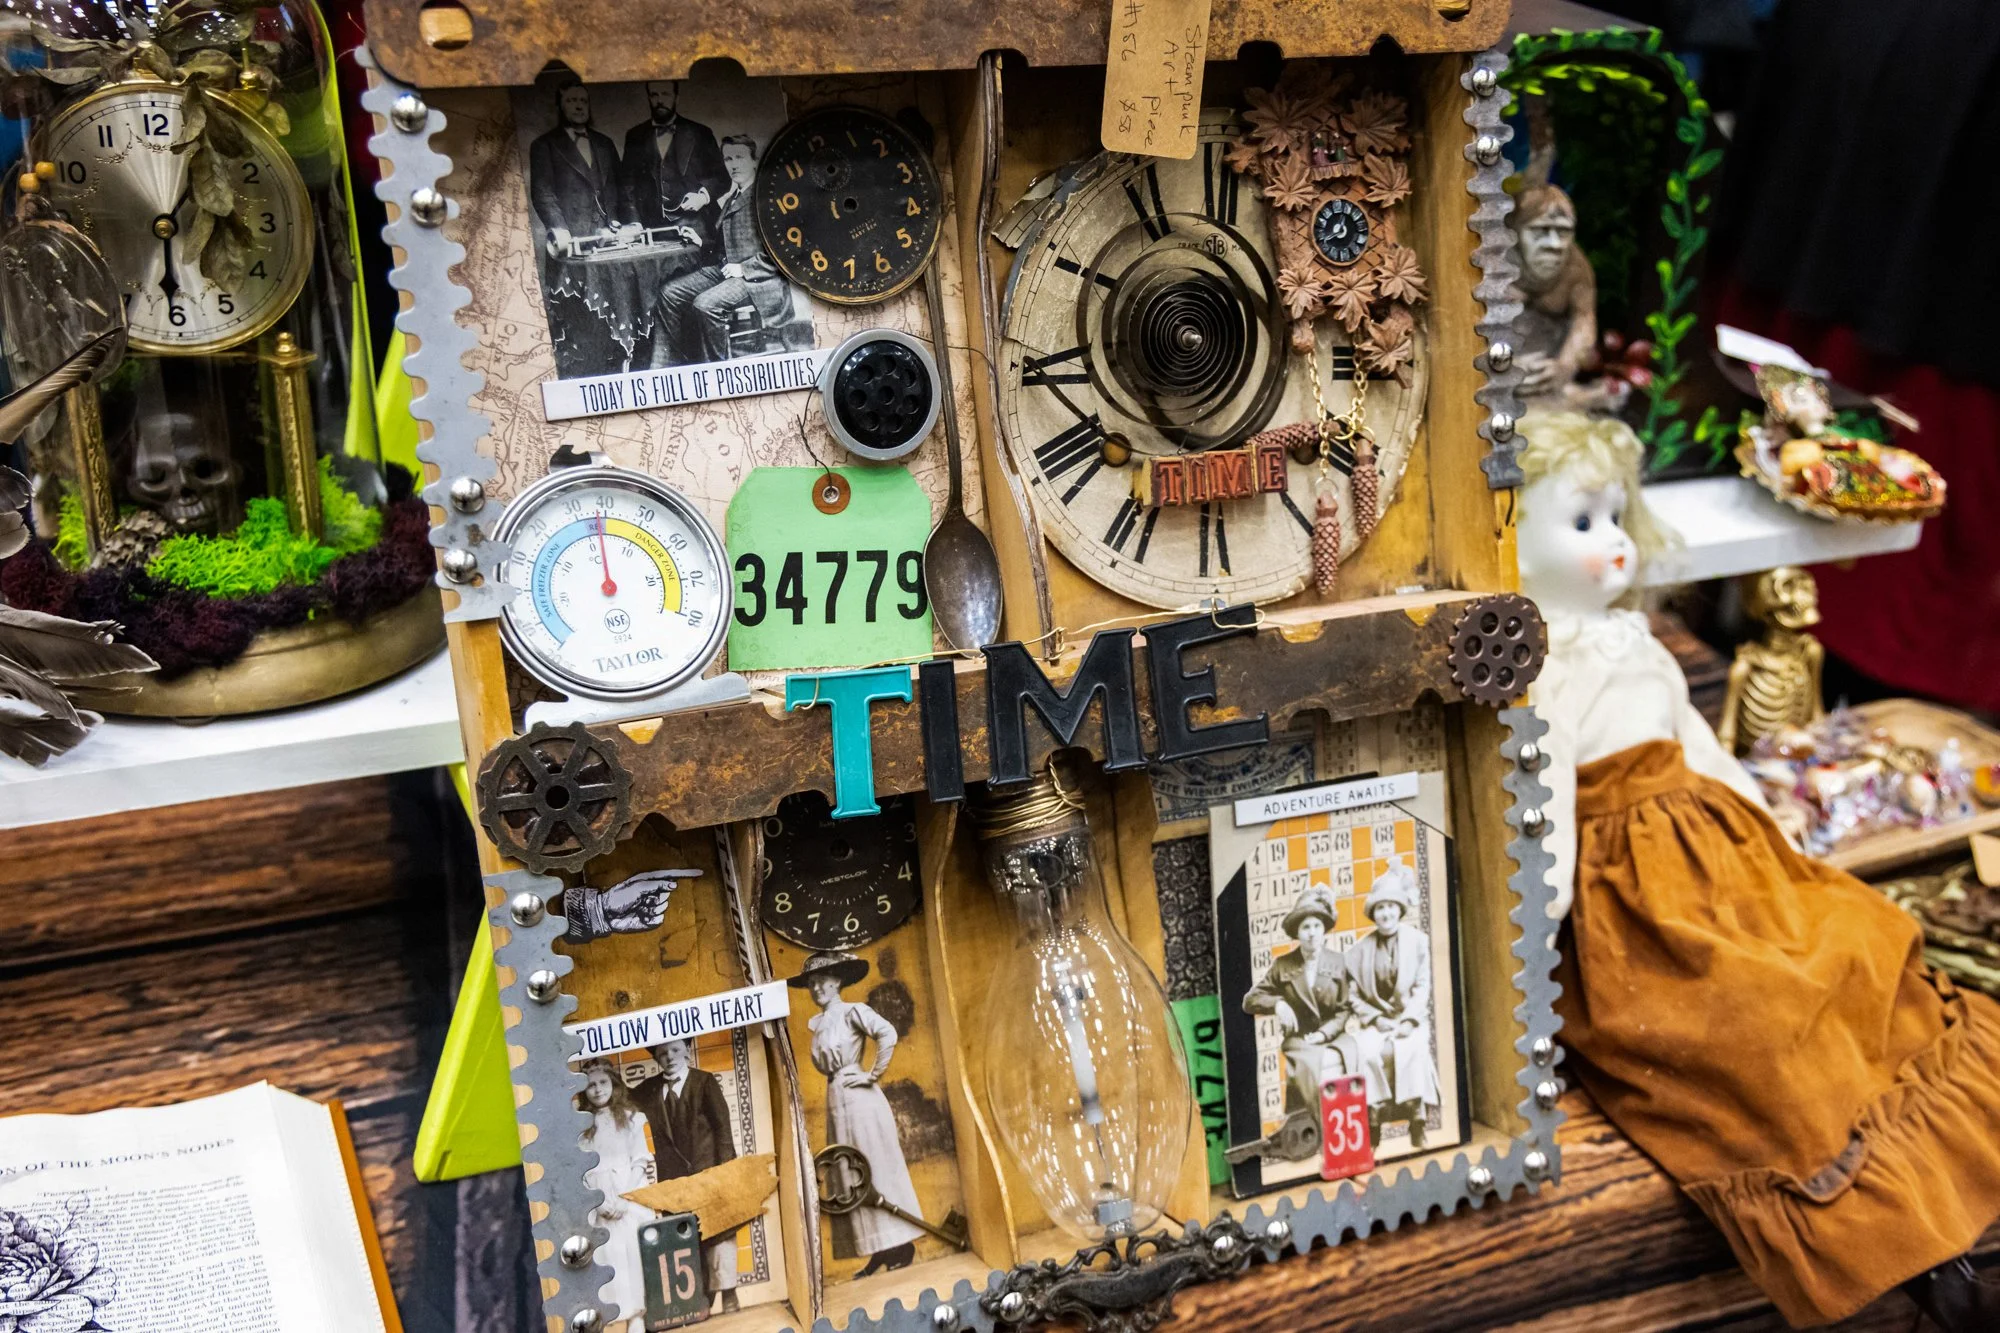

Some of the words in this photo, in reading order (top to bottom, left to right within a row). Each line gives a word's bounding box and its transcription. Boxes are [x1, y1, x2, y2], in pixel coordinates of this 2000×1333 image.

[1163, 39, 1179, 93] Art
[143, 113, 170, 136] 12
[98, 124, 114, 148] 11
[59, 160, 87, 185] 10
[241, 162, 260, 185] 2
[896, 161, 914, 184] 3
[776, 192, 800, 216] 10
[906, 196, 922, 217] 4
[259, 212, 277, 234] 3
[786, 226, 802, 248] 9
[895, 227, 913, 249] 5
[249, 259, 268, 280] 4
[810, 250, 829, 272] 8
[843, 258, 856, 281] 7
[875, 252, 894, 274] 6
[218, 293, 235, 315] 5
[168, 305, 187, 326] 6
[580, 380, 625, 414] TODAY
[631, 377, 648, 407] IS
[652, 372, 689, 404] FULL
[693, 370, 710, 399] OF
[716, 357, 817, 397] POSSIBILITIES
[1154, 443, 1288, 507] TIME
[561, 497, 582, 515] 30
[595, 495, 614, 510] 40
[635, 504, 655, 523] 50
[528, 517, 548, 536] 20
[545, 542, 562, 563] ZONE
[621, 546, 634, 559] 10
[668, 532, 688, 551] 60
[511, 550, 527, 568] 10
[635, 532, 664, 560] DANGER
[661, 557, 676, 582] ZONE
[537, 563, 550, 597] FREEZER
[689, 569, 705, 588] 70
[733, 549, 929, 627] 34779
[541, 597, 554, 618] SAFE
[687, 610, 705, 628] 80
[592, 646, 664, 674] TAYLOR
[785, 602, 1270, 820] TIME
[1263, 793, 1341, 817] ADVENTURE
[1347, 782, 1396, 803] AWAITS
[763, 817, 783, 838] 0
[1375, 825, 1394, 844] 68
[1270, 842, 1286, 862] 19
[820, 869, 869, 885] WESTCLOX
[897, 861, 913, 882] 4
[1254, 883, 1262, 901] 7
[1272, 879, 1287, 897] 11
[774, 892, 793, 914] 8
[876, 895, 892, 915] 5
[807, 912, 821, 934] 7
[843, 913, 860, 933] 6
[1251, 915, 1269, 935] 62
[1253, 949, 1272, 969] 68
[657, 1005, 705, 1039] YOUR
[709, 992, 764, 1029] HEART
[1328, 1105, 1364, 1156] 35
[56, 1160, 94, 1169] THE
[657, 1247, 696, 1305] 15
